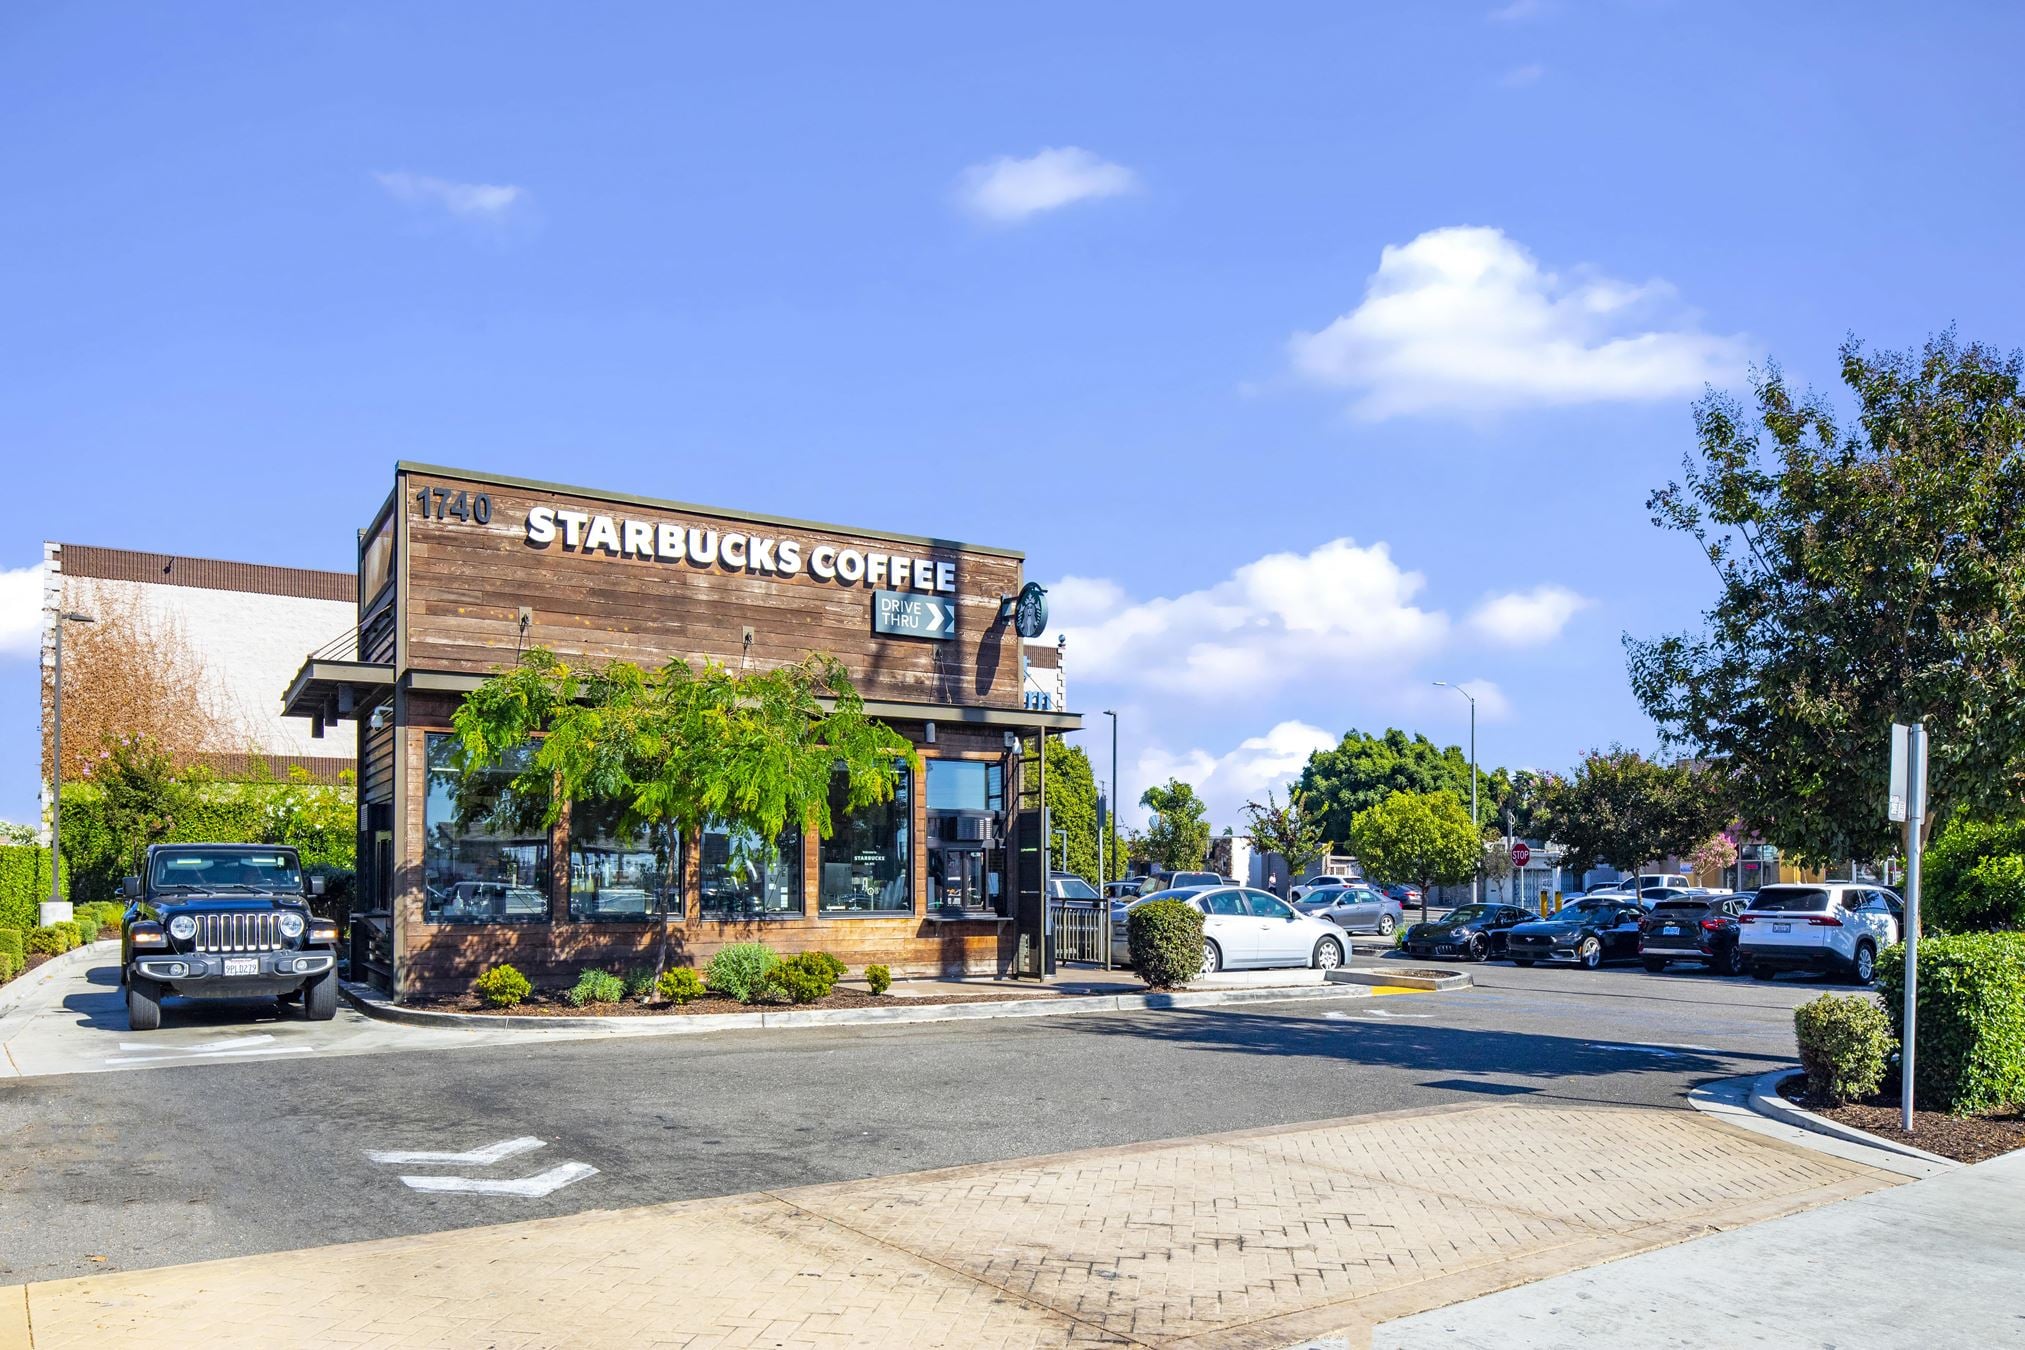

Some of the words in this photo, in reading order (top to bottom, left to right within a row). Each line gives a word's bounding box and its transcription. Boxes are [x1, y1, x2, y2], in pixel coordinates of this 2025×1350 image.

[417, 486, 491, 525] 1740
[526, 506, 801, 574] STARBUCKS
[809, 545, 956, 593] COFFEE
[881, 598, 922, 615] DRIVE
[881, 612, 919, 629] THRU
[1512, 850, 1529, 860] STOP
